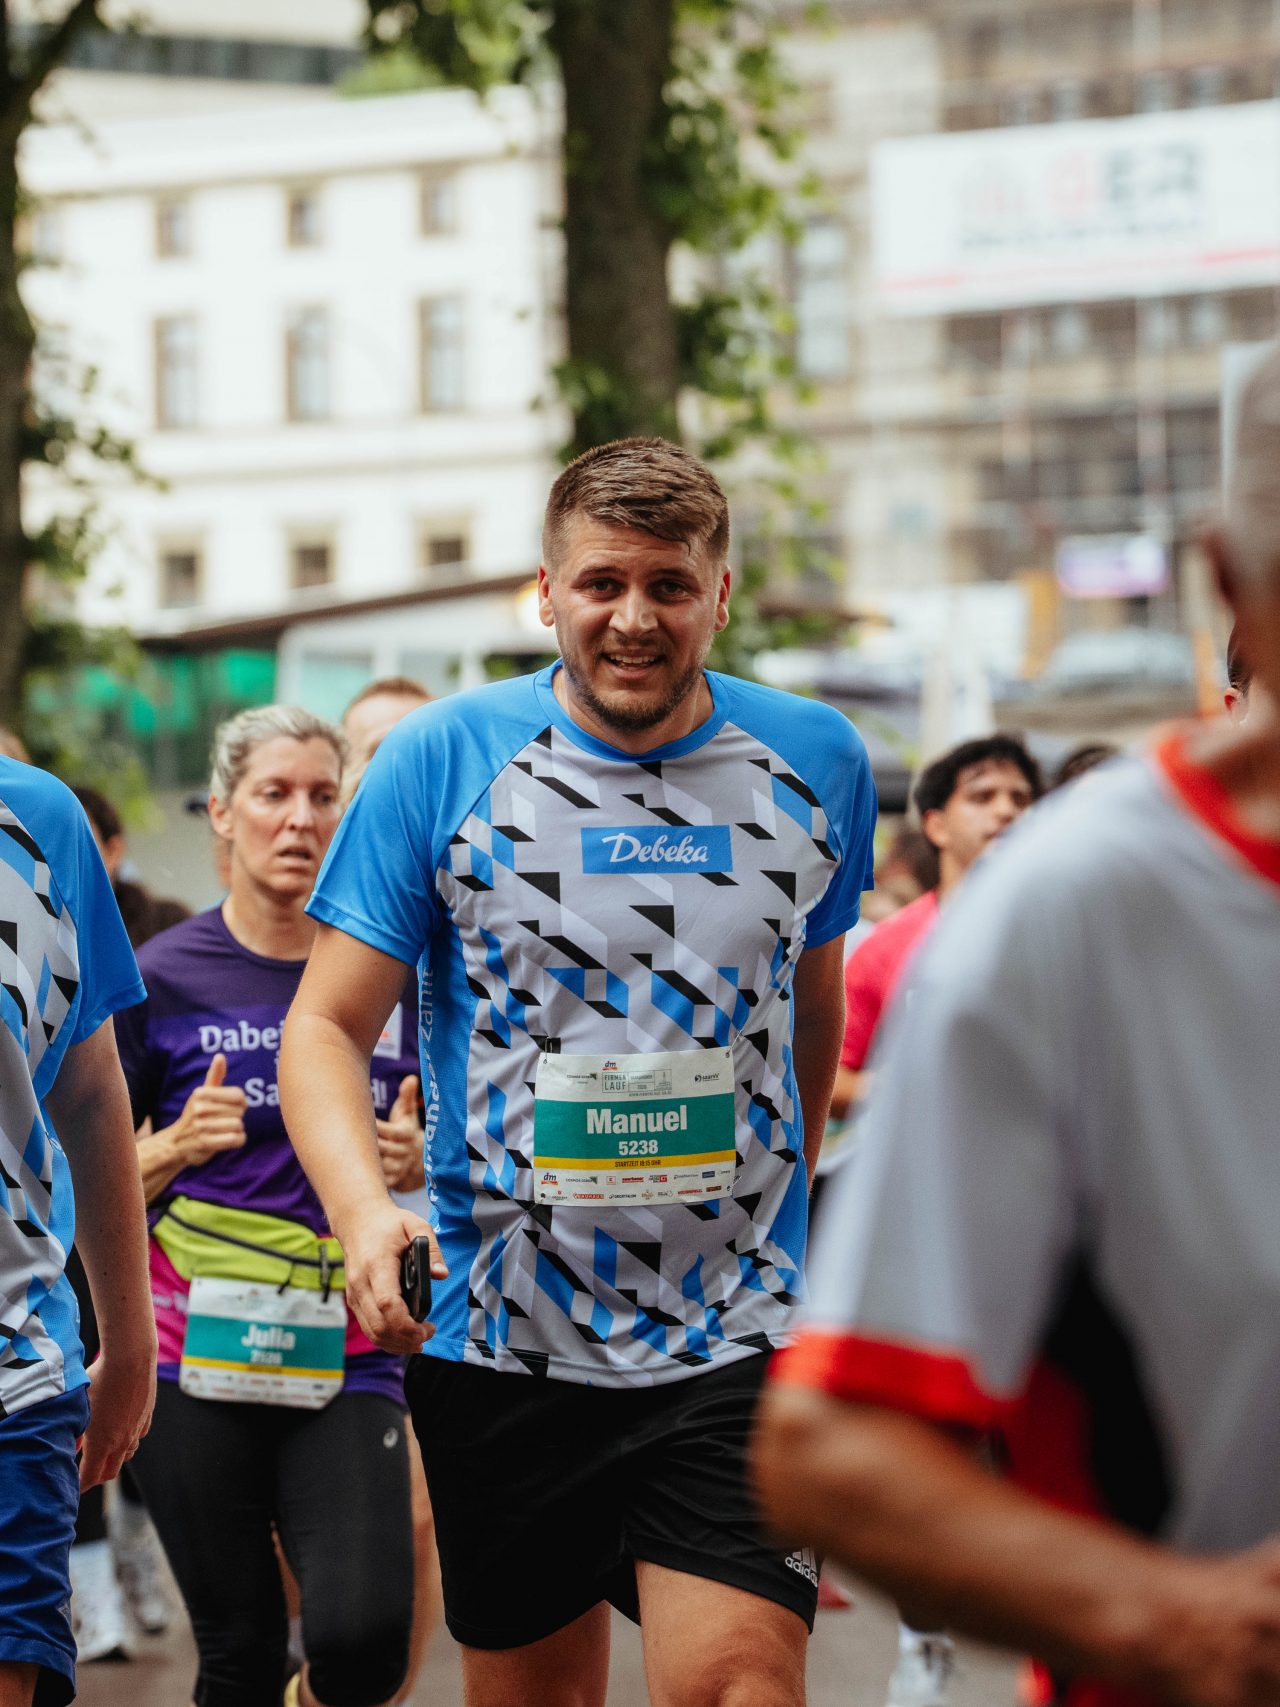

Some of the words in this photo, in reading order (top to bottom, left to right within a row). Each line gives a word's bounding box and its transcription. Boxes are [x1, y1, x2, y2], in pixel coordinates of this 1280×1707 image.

[601, 832, 710, 864] Debeka
[604, 1082, 627, 1091] LAUF
[586, 1104, 688, 1135] Manuel
[618, 1139, 659, 1156] 5238
[543, 1172, 557, 1181] dm
[241, 1323, 297, 1350] Julia
[785, 1556, 818, 1588] adida
